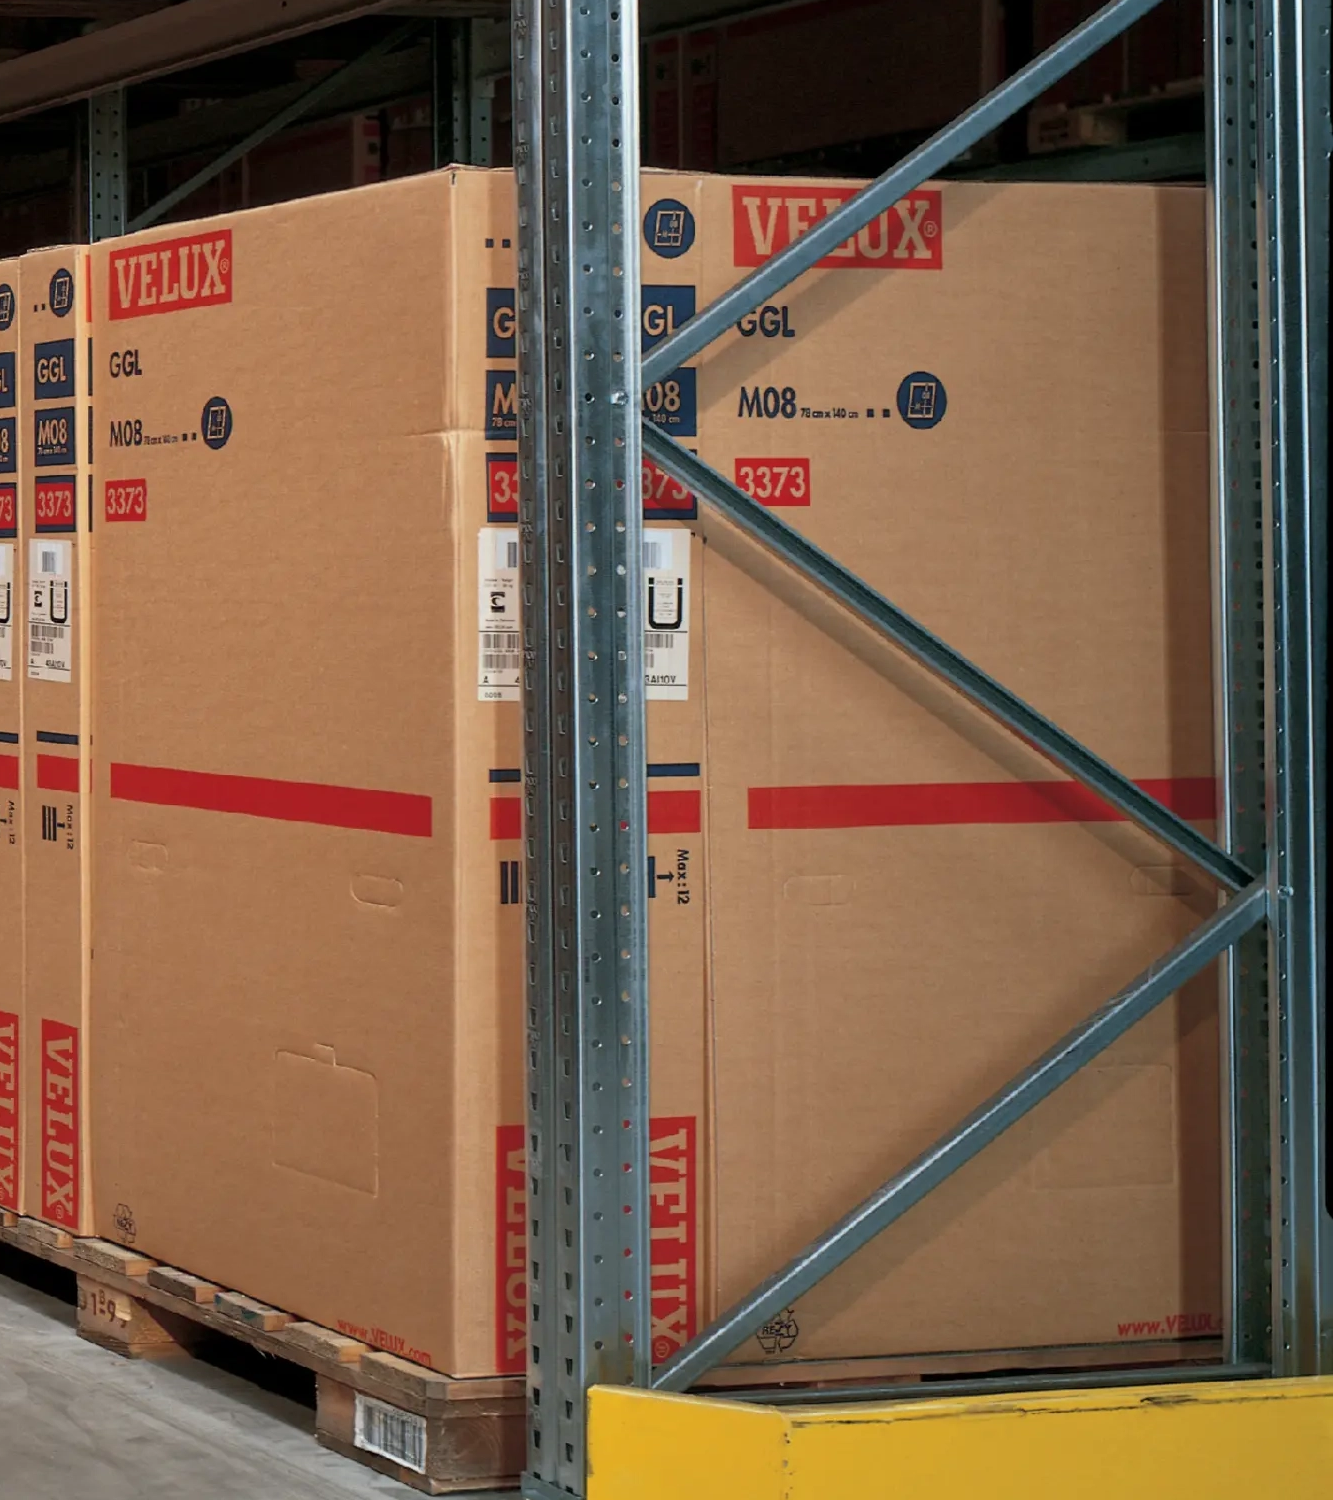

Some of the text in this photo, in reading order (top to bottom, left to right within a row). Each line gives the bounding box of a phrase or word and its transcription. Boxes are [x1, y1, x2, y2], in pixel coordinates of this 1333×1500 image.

[114, 240, 225, 308] VELUX
[737, 306, 795, 338] GGL
[37, 357, 67, 383] GGL
[110, 350, 142, 378] GGL
[738, 387, 796, 419] M08
[38, 417, 67, 446] M08
[738, 466, 805, 498] 3373
[37, 489, 72, 517] 3373
[107, 487, 144, 514] 3373
[46, 1036, 72, 1214] VELUX
